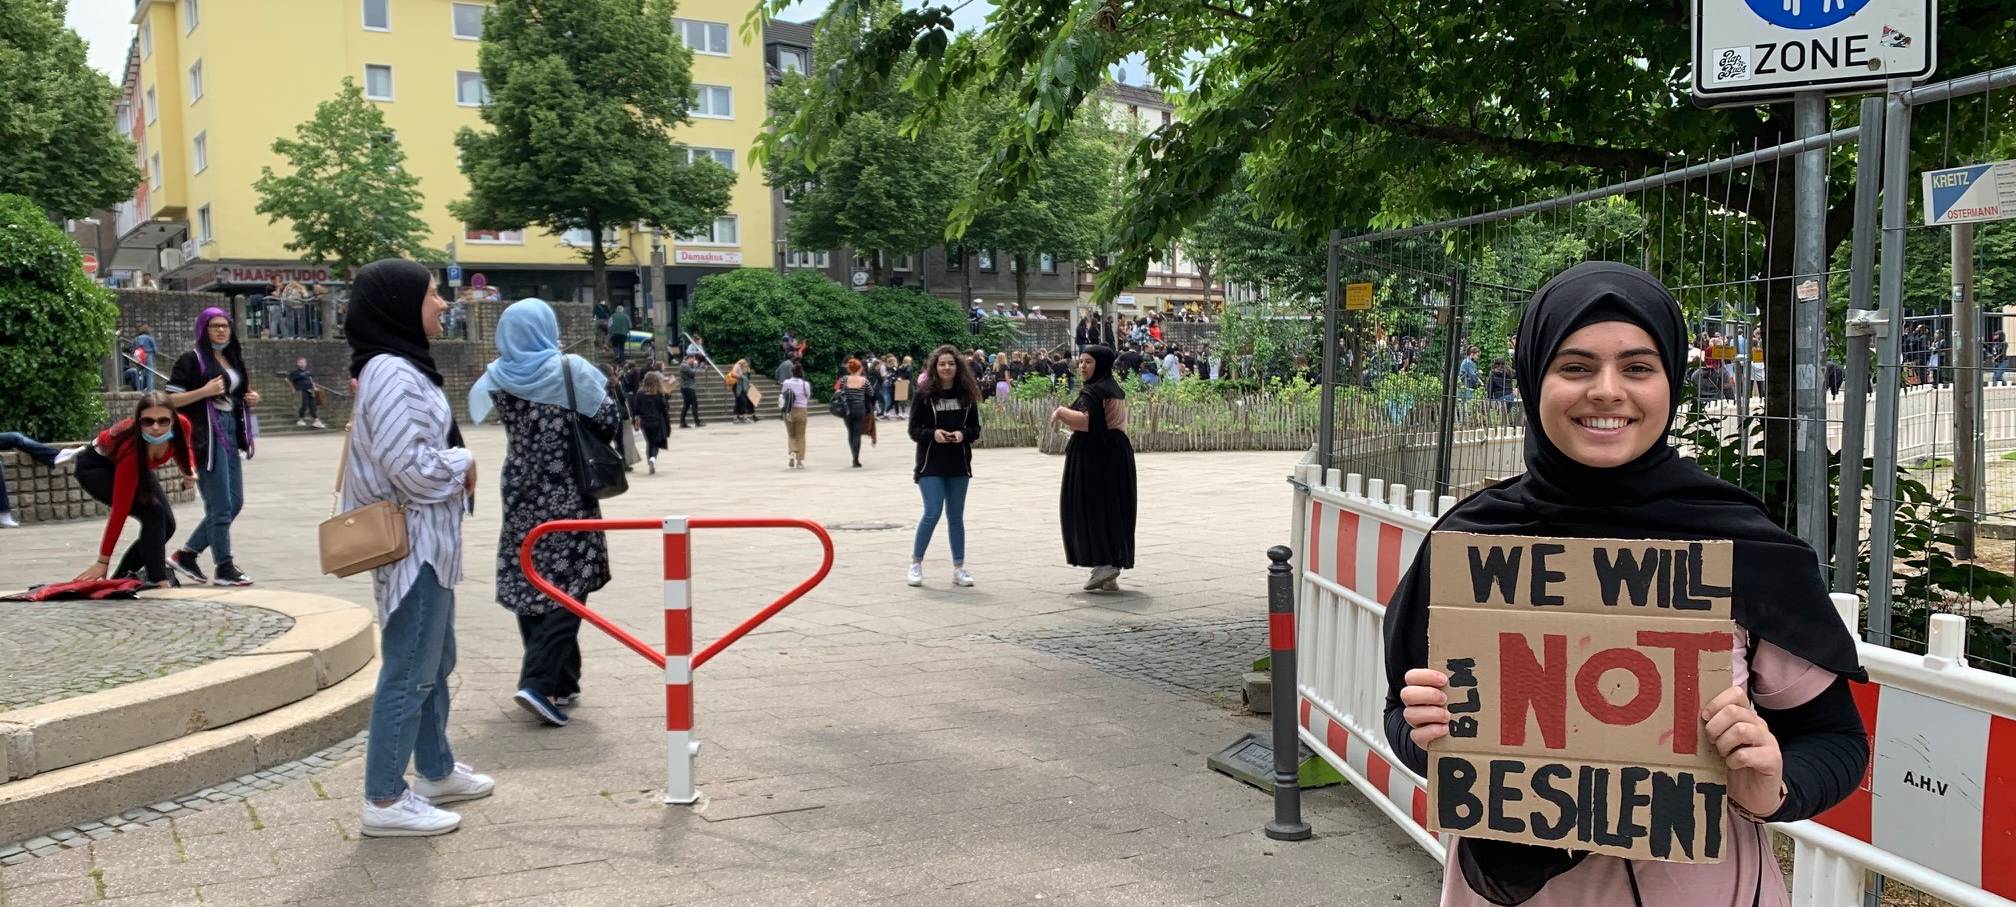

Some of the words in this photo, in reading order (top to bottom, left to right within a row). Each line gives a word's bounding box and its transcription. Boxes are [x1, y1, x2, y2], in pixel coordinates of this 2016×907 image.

[1754, 34, 1869, 75] ZONE
[1933, 171, 1970, 188] KREITZ
[1947, 206, 1998, 219] OSTERMANN
[1467, 543, 1566, 607] WE
[1593, 543, 1732, 611] WILL
[1447, 657, 1481, 738] BLM
[1498, 630, 1734, 755] NOT
[1903, 770, 1949, 797] A.H.V
